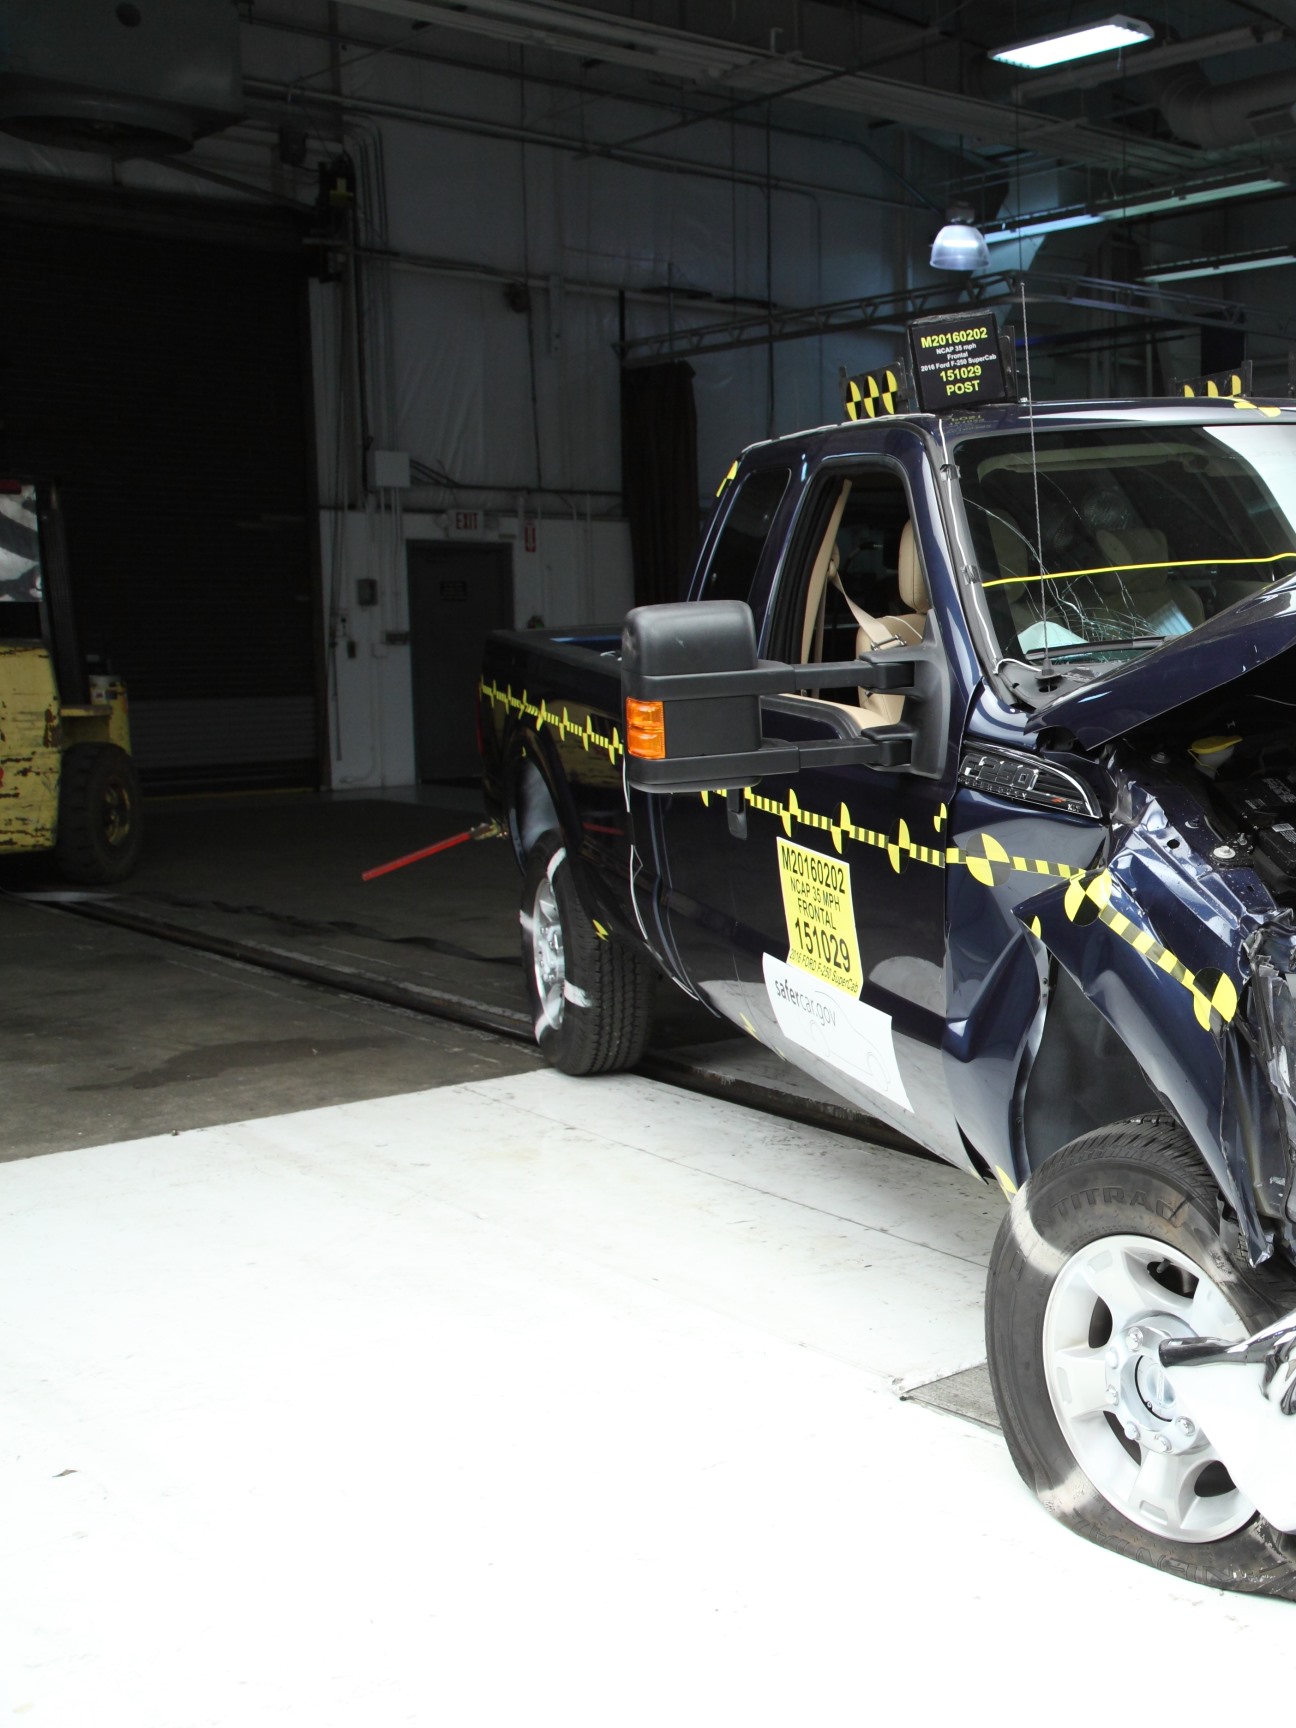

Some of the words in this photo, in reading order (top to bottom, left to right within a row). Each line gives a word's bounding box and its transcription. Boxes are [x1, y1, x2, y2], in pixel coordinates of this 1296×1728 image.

[920, 327, 988, 348] M20160202
[936, 346, 954, 355] NCAP
[955, 344, 963, 352] 35
[963, 343, 977, 351] mph
[947, 351, 969, 360] Frontal
[936, 361, 950, 370] Ford
[951, 359, 967, 367] F-250
[968, 354, 997, 364] SuperCab
[940, 365, 982, 382] 151029
[946, 380, 980, 396] POST
[456, 511, 479, 529] EXIT
[781, 845, 846, 895] M20160202
[790, 876, 811, 898] NCAP
[812, 886, 821, 903] 35
[822, 890, 841, 912] MPH
[797, 898, 837, 931] FRONTAL
[795, 918, 851, 973] 151029
[789, 948, 802, 963] 2016
[802, 954, 817, 971] FORD
[816, 962, 832, 979] F-250
[832, 970, 859, 994] SuperCab
[775, 979, 836, 1027] safercar.gov
